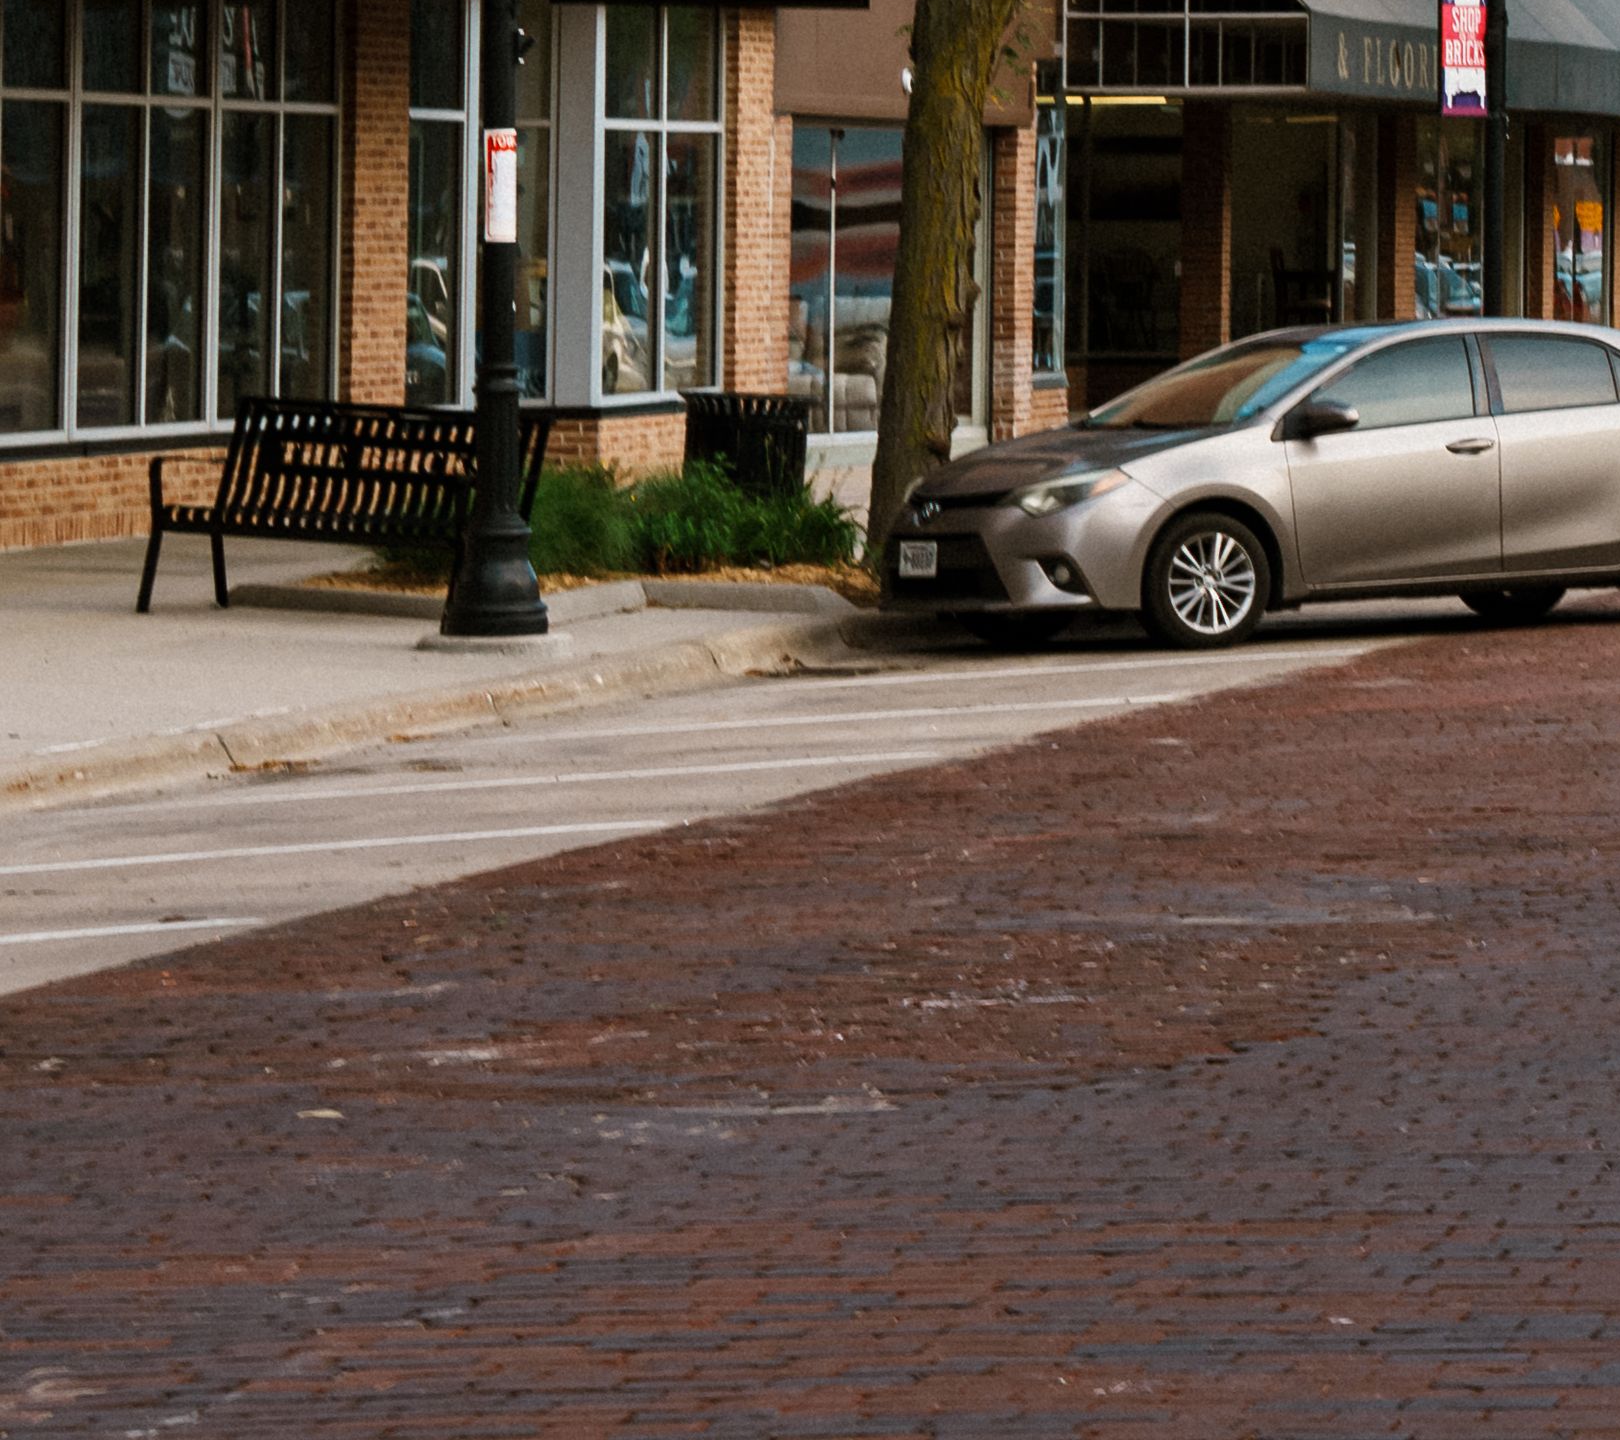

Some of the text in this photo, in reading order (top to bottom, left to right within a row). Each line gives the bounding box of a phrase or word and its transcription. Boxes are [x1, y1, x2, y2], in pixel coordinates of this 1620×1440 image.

[1452, 6, 1482, 33] SHOP
[1363, 36, 1438, 91] FLOORI
[1445, 39, 1486, 67] BRICKS
[280, 440, 348, 469] THE
